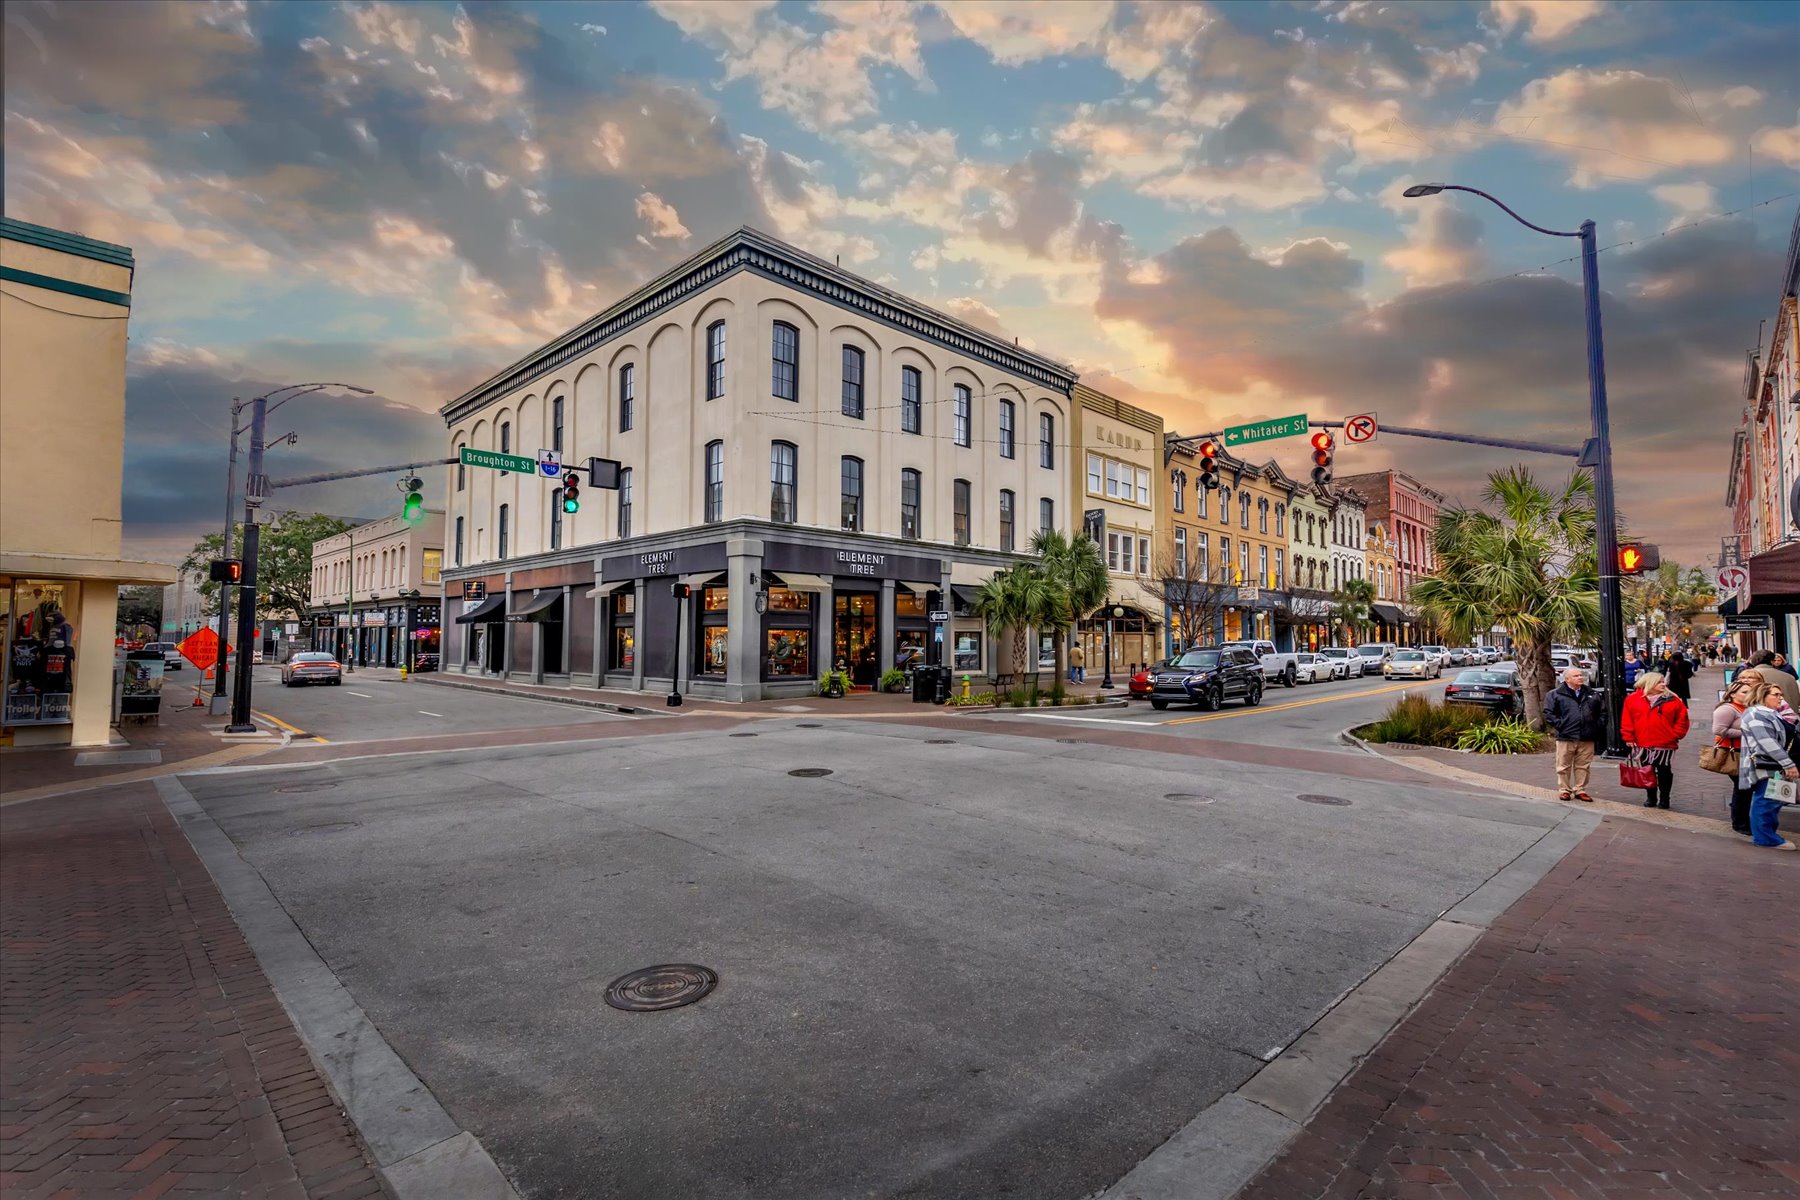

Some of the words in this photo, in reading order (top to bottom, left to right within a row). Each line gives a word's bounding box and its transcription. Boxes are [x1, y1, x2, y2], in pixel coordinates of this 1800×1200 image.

[1242, 424, 1288, 440] Whitaker
[1293, 419, 1305, 431] St
[466, 452, 515, 468] Broughton
[521, 460, 530, 471] St
[641, 551, 673, 564] ELEMENT
[839, 551, 885, 565] ELEMENT
[648, 563, 665, 574] TREE
[851, 563, 875, 575] TREE
[7, 704, 41, 714] Trolley
